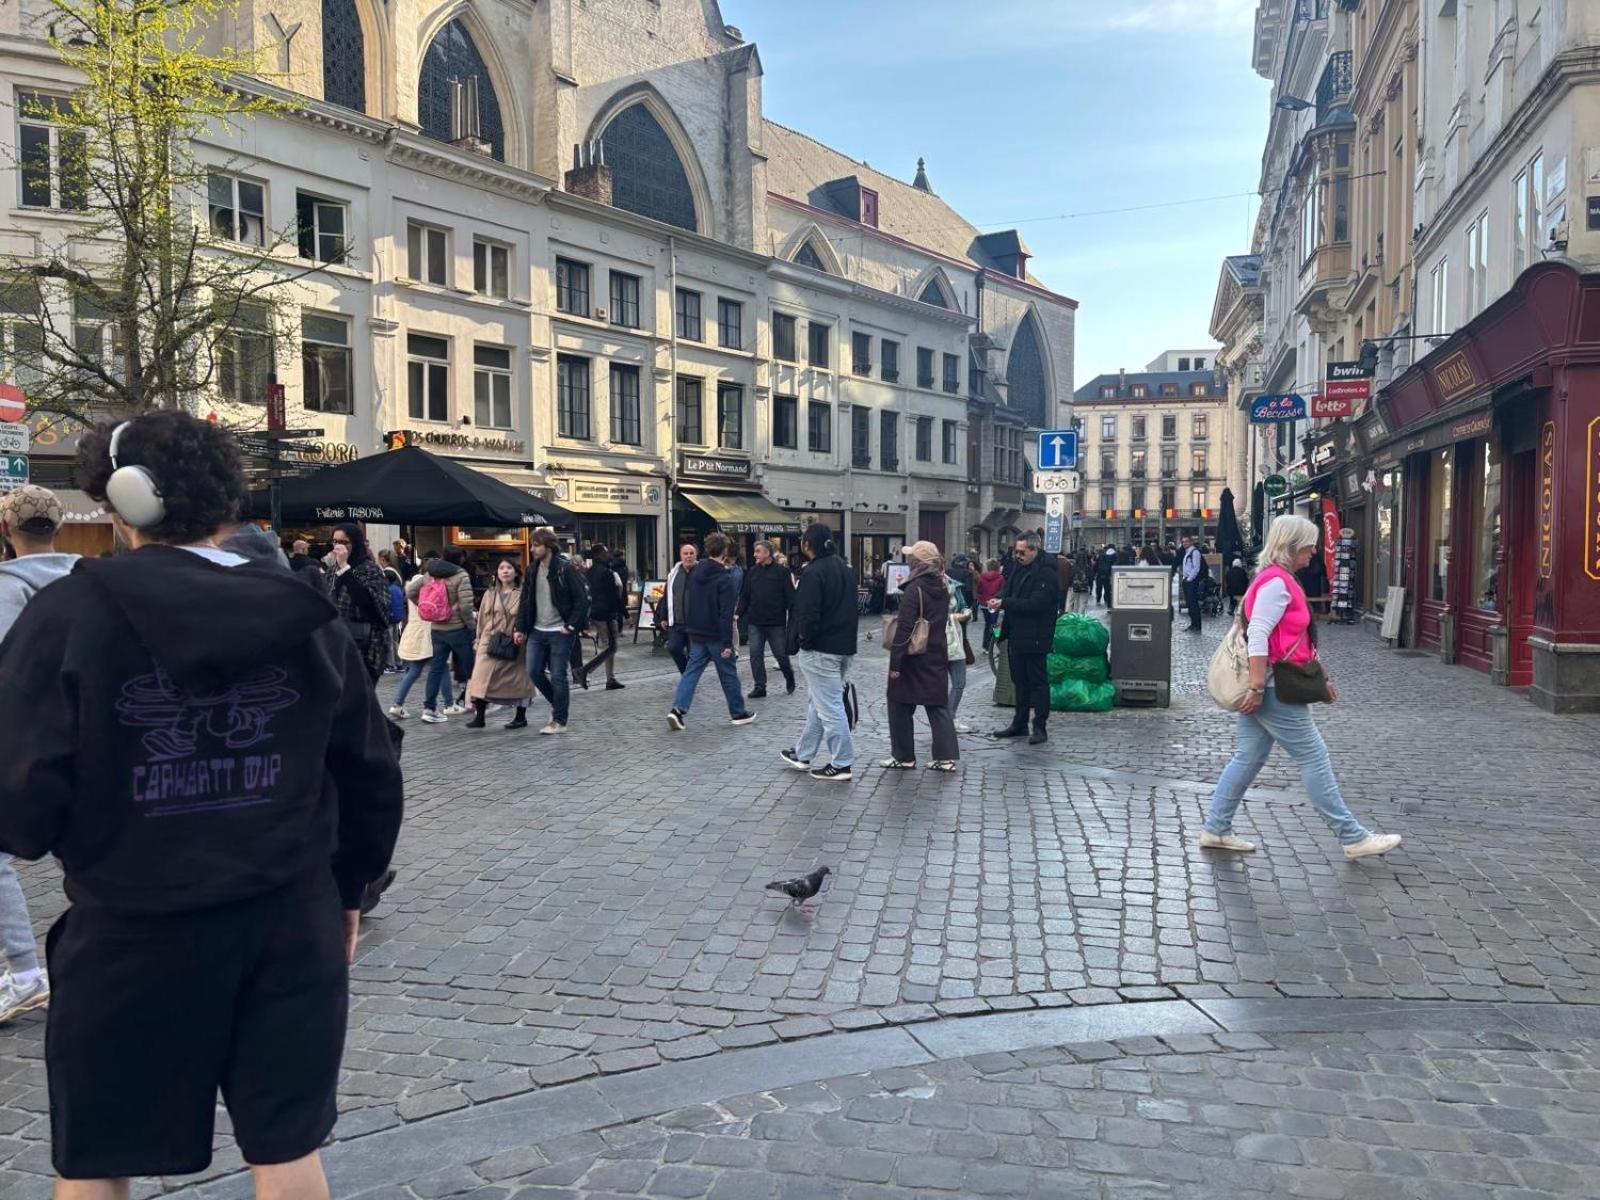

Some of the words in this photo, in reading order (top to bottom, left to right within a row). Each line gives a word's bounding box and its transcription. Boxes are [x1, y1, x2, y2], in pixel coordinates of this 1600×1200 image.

[1333, 365, 1364, 376] bwin
[1438, 359, 1471, 391] NICOLAS
[688, 460, 697, 470] Le
[698, 460, 714, 471] P'tit
[715, 462, 748, 473] Normand
[1542, 431, 1553, 567] NICOLAS
[348, 507, 384, 519] TABORA
[132, 757, 235, 802] CARHARTT
[244, 753, 281, 790] WIP
